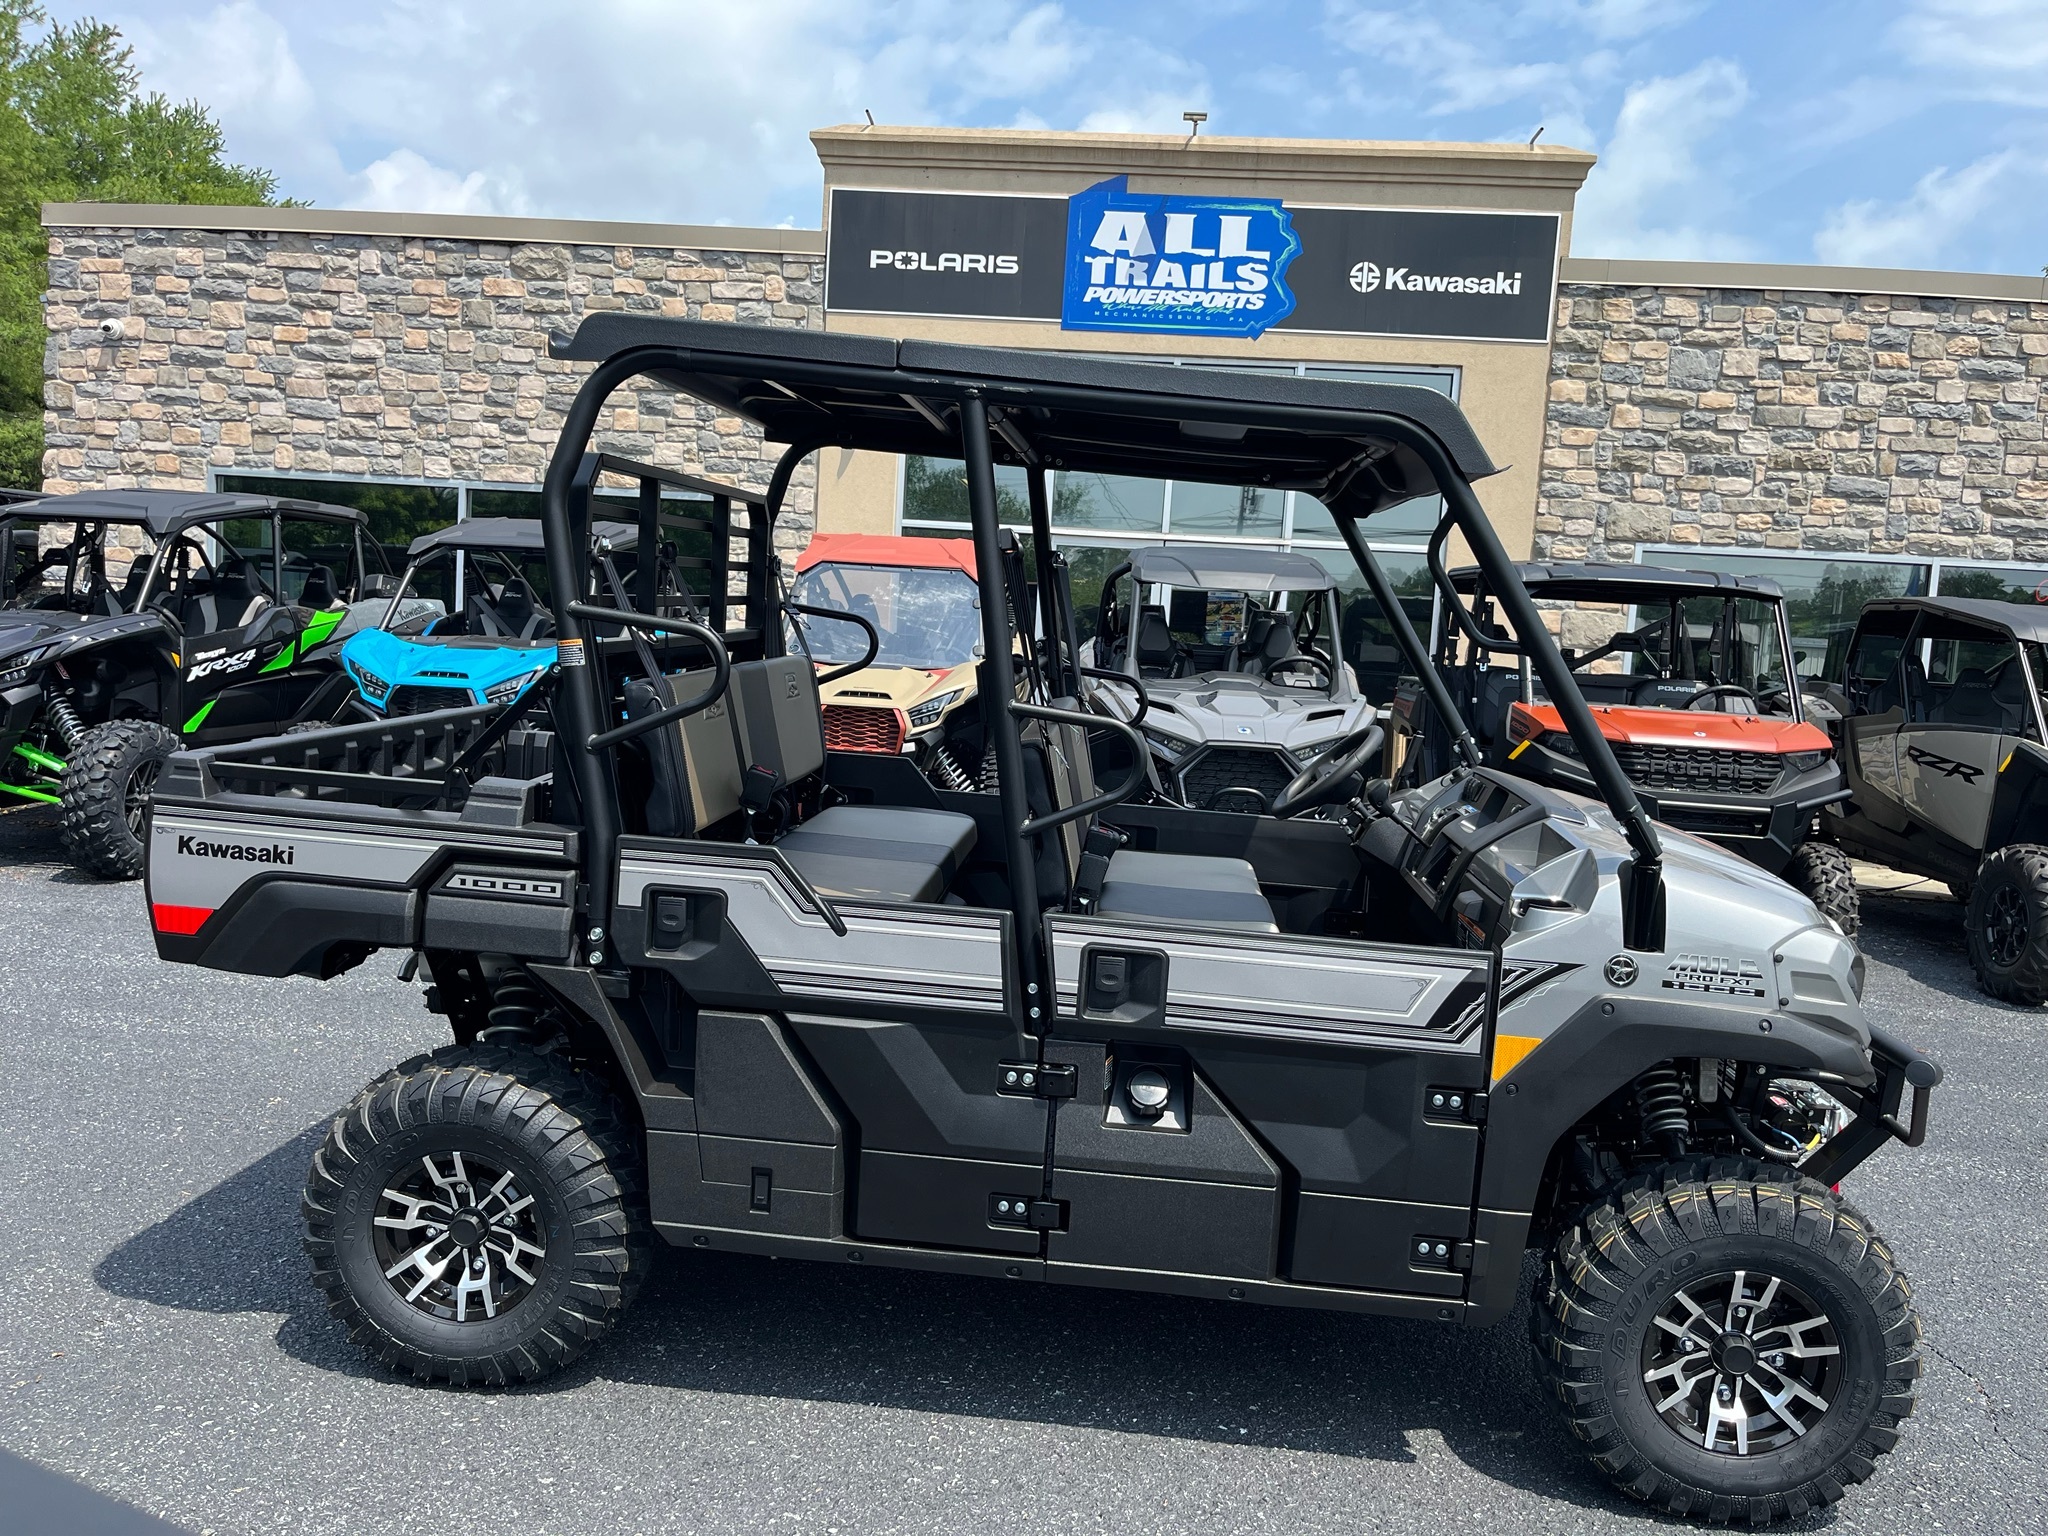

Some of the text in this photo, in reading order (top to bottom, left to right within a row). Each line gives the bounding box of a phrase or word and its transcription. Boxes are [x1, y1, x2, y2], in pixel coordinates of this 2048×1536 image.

[1090, 211, 1270, 262] ALL
[870, 250, 1019, 274] POLARIS
[1084, 255, 1269, 291] TRAILS
[1385, 267, 1522, 295] Kawasaki
[1083, 286, 1266, 310] POWERSPORTS
[226, 661, 250, 674] 1000
[1657, 685, 1698, 694] POLARIS
[1650, 759, 1755, 779] POLARIS
[1907, 744, 1985, 786] RZR
[177, 834, 295, 865] Kawasaki
[457, 876, 557, 895] 1000
[1666, 952, 1764, 980] MULE
[1610, 1250, 1699, 1360] DURO
